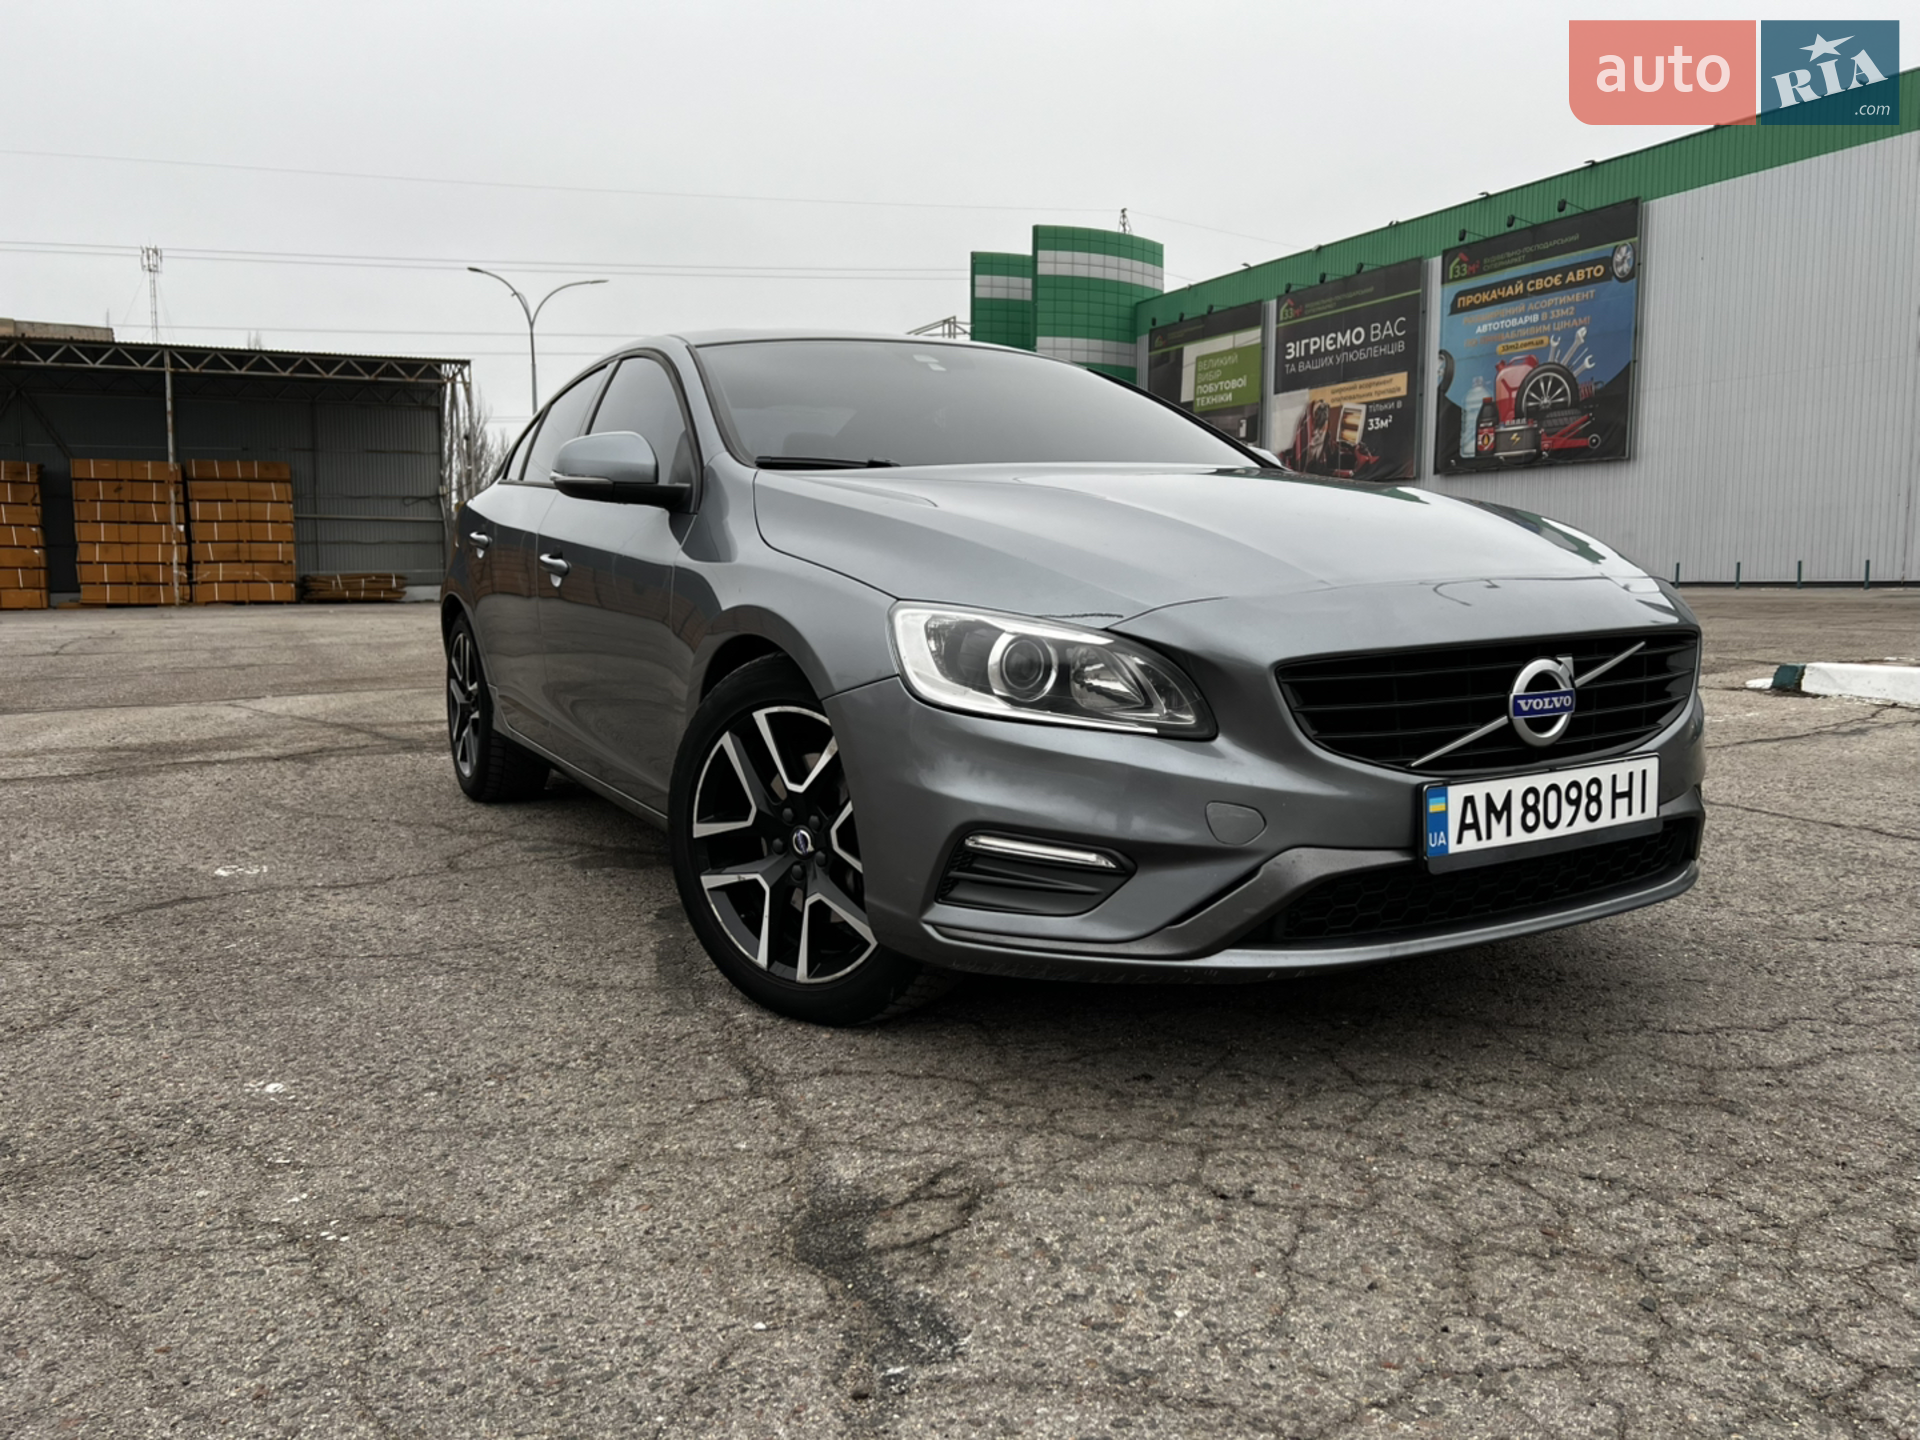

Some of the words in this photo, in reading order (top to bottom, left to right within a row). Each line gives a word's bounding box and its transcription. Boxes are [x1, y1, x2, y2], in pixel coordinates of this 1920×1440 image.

[1457, 281, 1524, 308] ПРОКАЧАЙ
[1527, 276, 1563, 292] СВОЄ
[1565, 264, 1605, 284] АВТО
[1527, 289, 1596, 312] АСОРТИМЕНТ
[1475, 313, 1540, 335] АВТОТОВАРІВ
[1541, 310, 1548, 321] В
[1550, 306, 1576, 320] 33М2
[1553, 316, 1591, 332] ЦІНАМ!
[1284, 327, 1365, 360] ЗІГРІЄМО
[1370, 317, 1406, 342] ВАС
[1501, 338, 1544, 352] 33m2.com.ua
[1197, 353, 1239, 372] ВЕЛИКИЙ
[1285, 363, 1297, 375] ТА
[1298, 354, 1334, 373] ВАШИХ
[1335, 340, 1406, 365] УЛЮБЛЕНЦІВ
[1196, 375, 1247, 396] ПОБУТОВОЇ
[1197, 369, 1222, 384] ВИБІР
[1196, 392, 1232, 407] ТЕХНІКИ
[1517, 695, 1572, 711] VOLVO
[1429, 831, 1447, 848] UA
